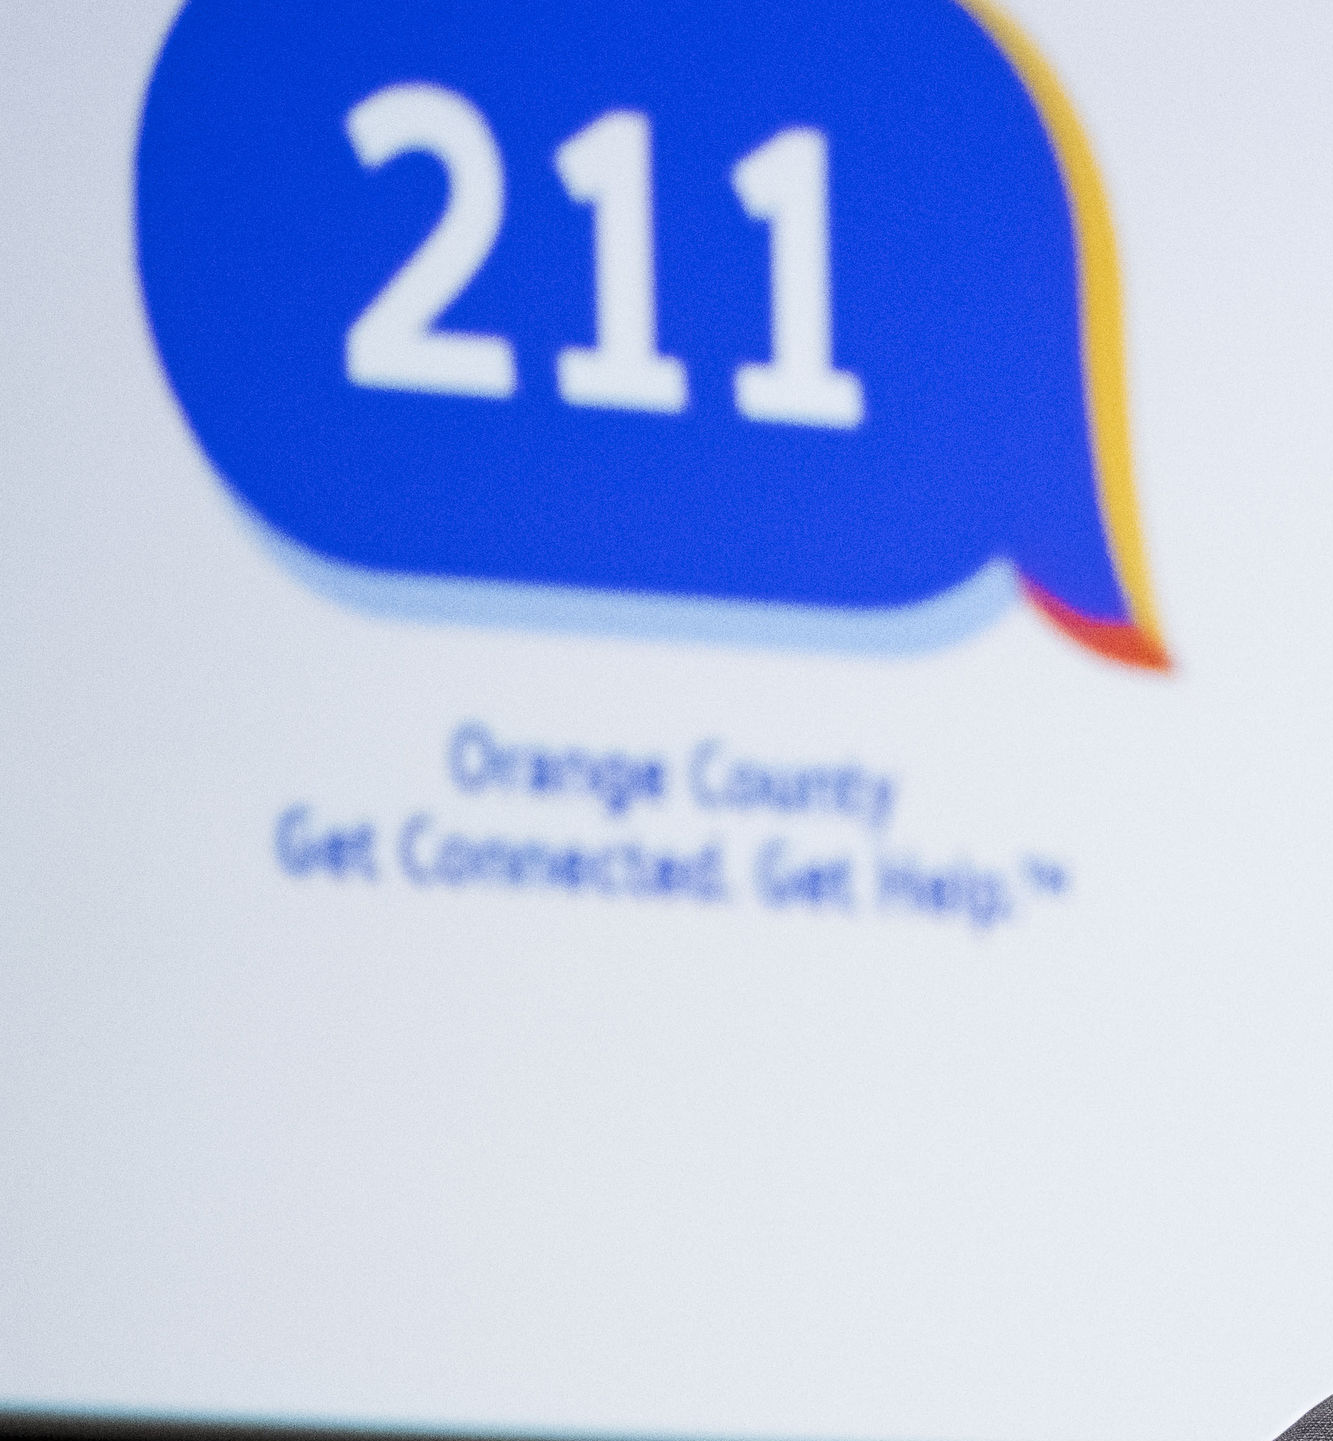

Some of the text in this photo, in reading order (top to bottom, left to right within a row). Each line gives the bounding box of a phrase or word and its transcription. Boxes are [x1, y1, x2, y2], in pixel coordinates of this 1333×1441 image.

[346, 82, 865, 430] 211
[447, 718, 898, 834] Orange County
[270, 800, 378, 882] Get
[752, 836, 857, 912] Get
